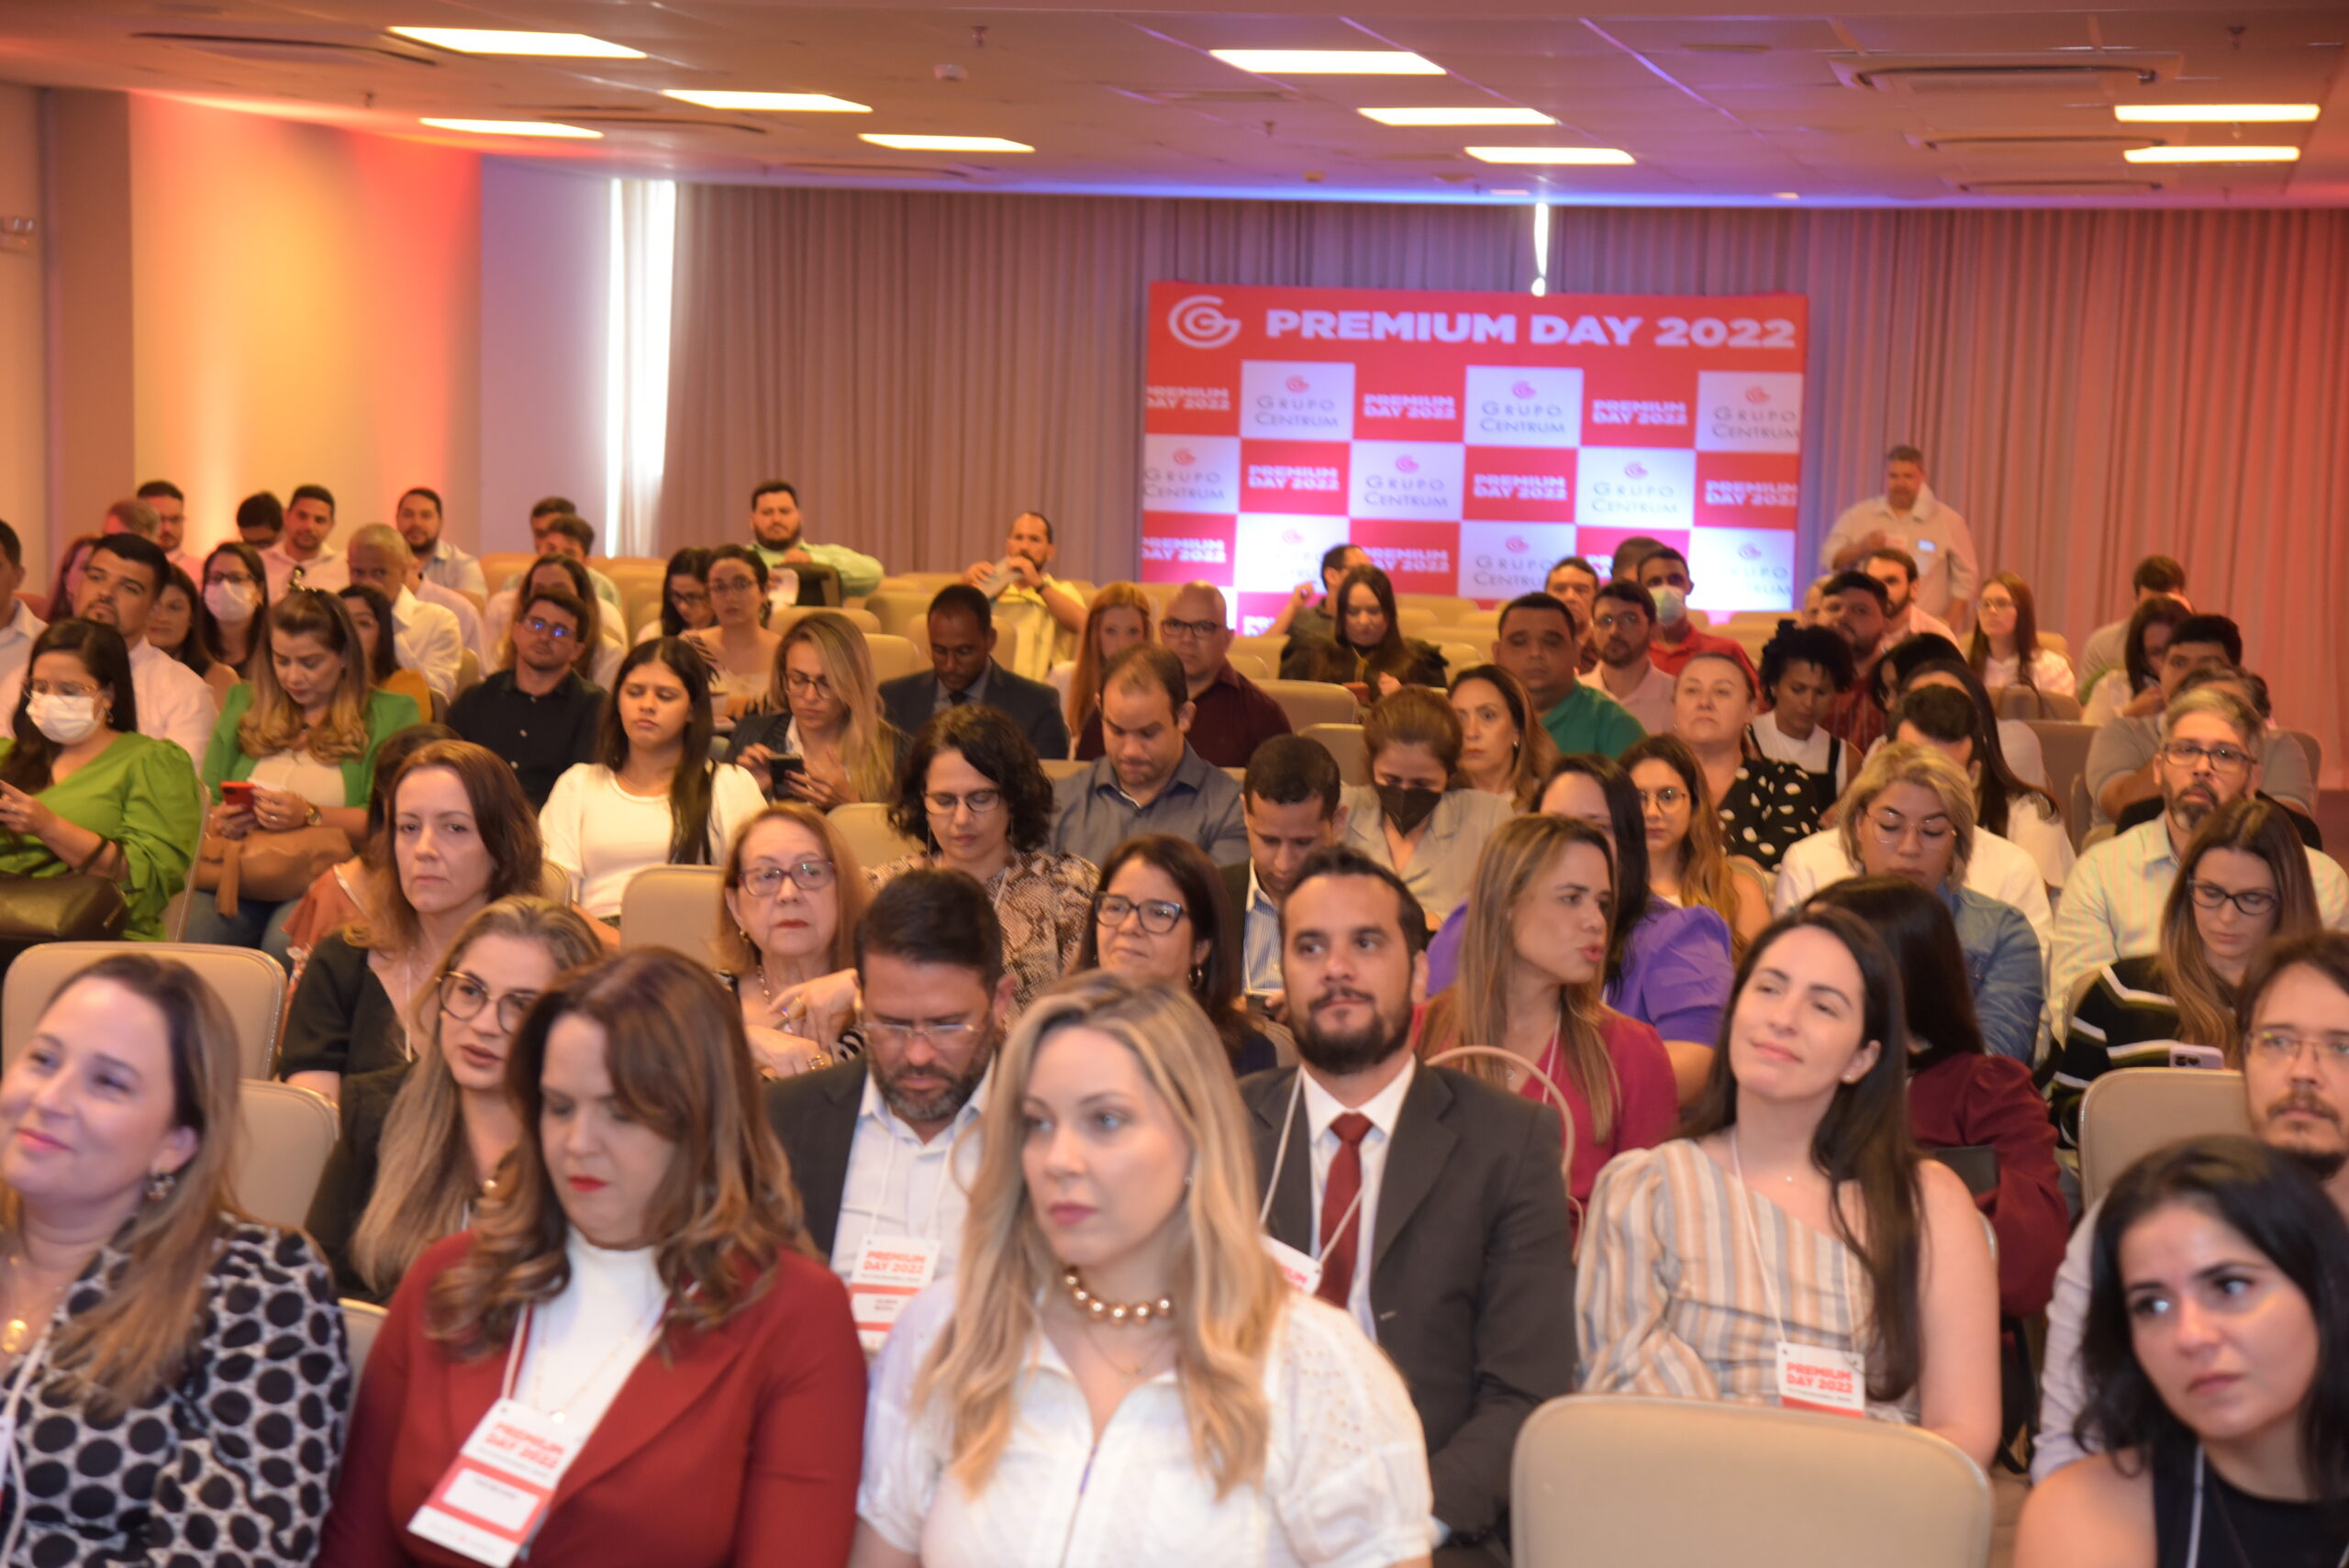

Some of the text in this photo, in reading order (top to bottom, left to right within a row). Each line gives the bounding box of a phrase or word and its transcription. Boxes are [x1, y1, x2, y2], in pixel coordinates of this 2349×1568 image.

[1265, 308, 1797, 349] PREMIUM DAY 2022
[1182, 397, 1230, 412] 2022
[1257, 395, 1335, 412] GRUPO
[1364, 394, 1455, 407] PREMIUM
[1481, 400, 1563, 417] GRUPO
[1592, 399, 1687, 414] PREMIUM
[1255, 411, 1339, 428] CENTRUM
[1364, 406, 1456, 421] DAY 2022
[1592, 411, 1687, 427] DAY 2022
[1714, 406, 1797, 423] GRUPO
[1480, 417, 1565, 434] CENTRUM
[1712, 423, 1799, 439] CENTRUM
[1144, 468, 1221, 484] GRUPO
[1247, 464, 1339, 478] PREMIUM
[1247, 476, 1340, 493] DAY 2022
[1366, 475, 1445, 491] GRUPO
[1474, 473, 1566, 487] PREMIUM
[1143, 484, 1225, 500] CENTRUM
[1474, 484, 1567, 501] DAY 2022
[1593, 482, 1675, 497] GRUPO
[1364, 491, 1449, 508] CENTRUM
[1591, 497, 1678, 514] CENTRUM
[1705, 492, 1746, 505] DAY
[1178, 550, 1227, 563] 2022
[1475, 554, 1554, 571] GRUPO
[1400, 559, 1451, 573] 2022
[1474, 572, 1543, 587] CENTRU
[863, 1261, 925, 1274] DAY 2022
[1786, 1362, 1853, 1382] PREMIUM
[1786, 1373, 1814, 1387] DAY
[1817, 1378, 1854, 1395] 2022
